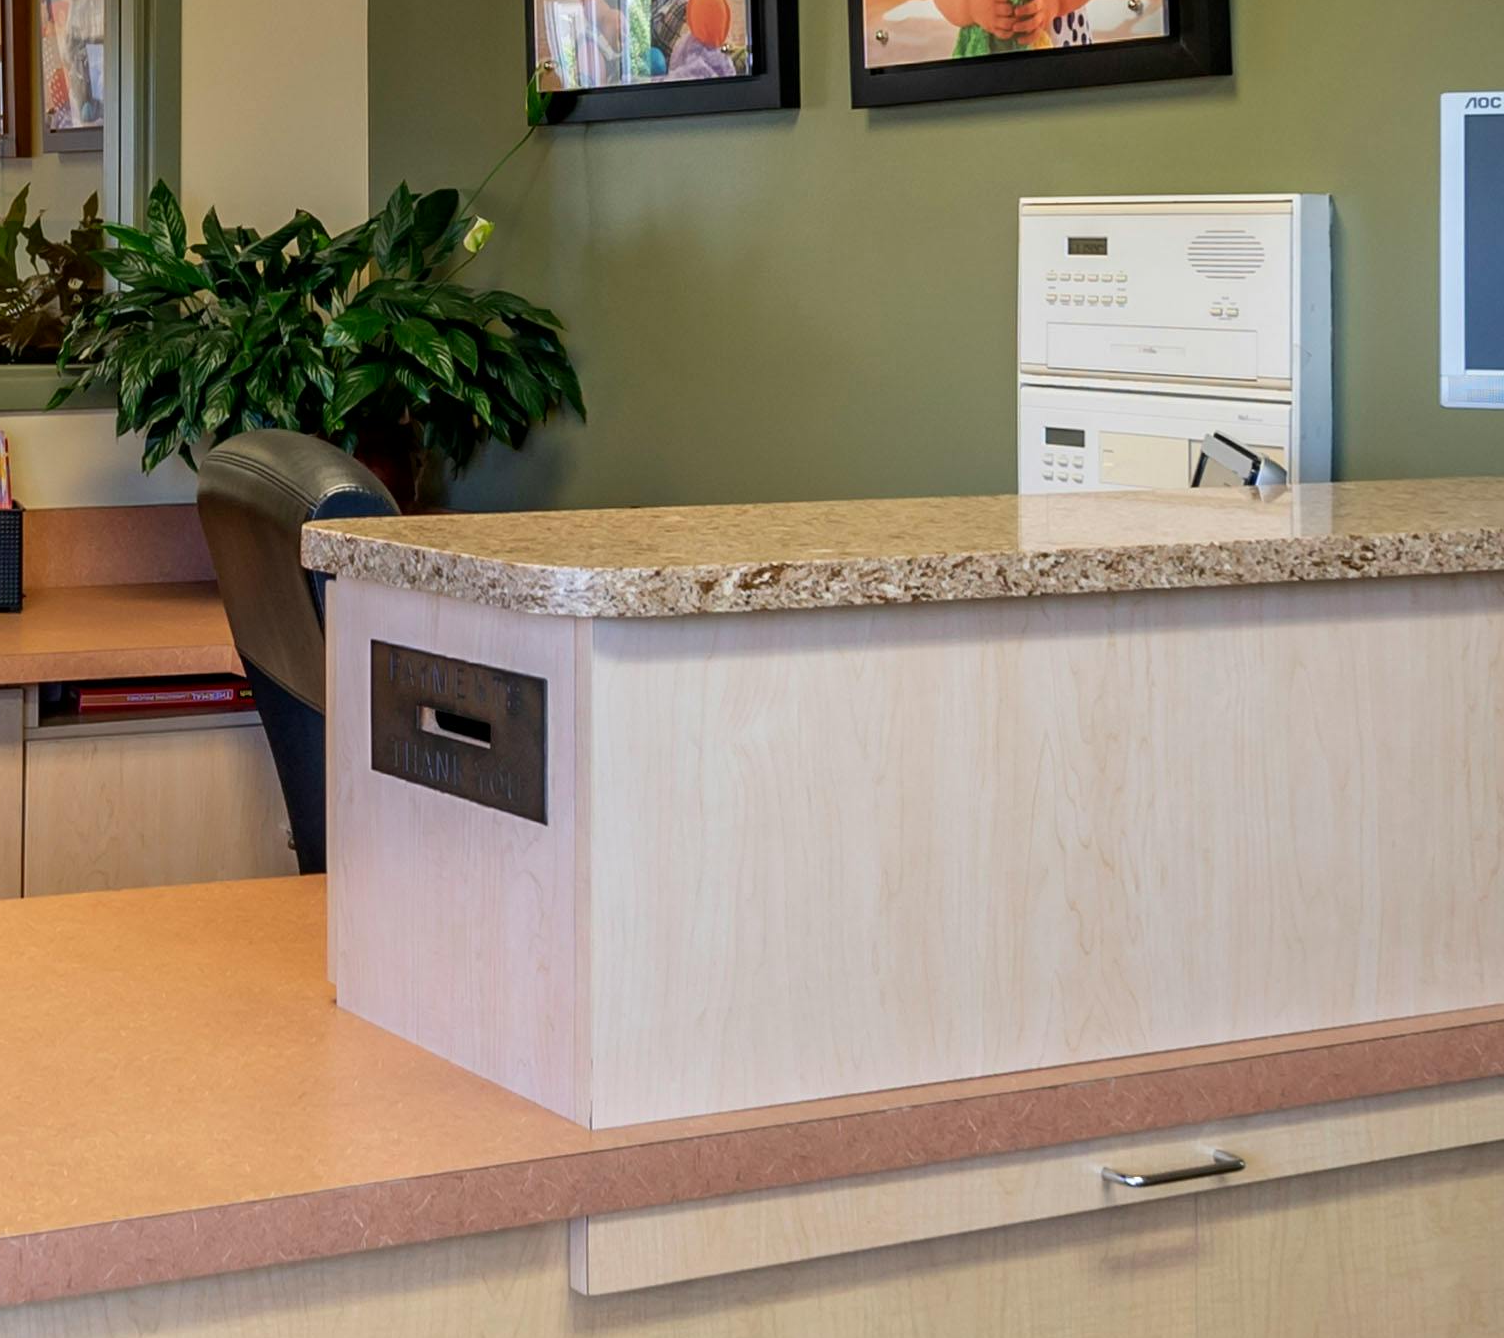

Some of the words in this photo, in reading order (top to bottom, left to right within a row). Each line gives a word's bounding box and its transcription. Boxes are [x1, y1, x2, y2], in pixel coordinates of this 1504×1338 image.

[1464, 97, 1502, 109] AOC
[192, 690, 232, 702] THERMAL
[392, 739, 462, 786] THANK
